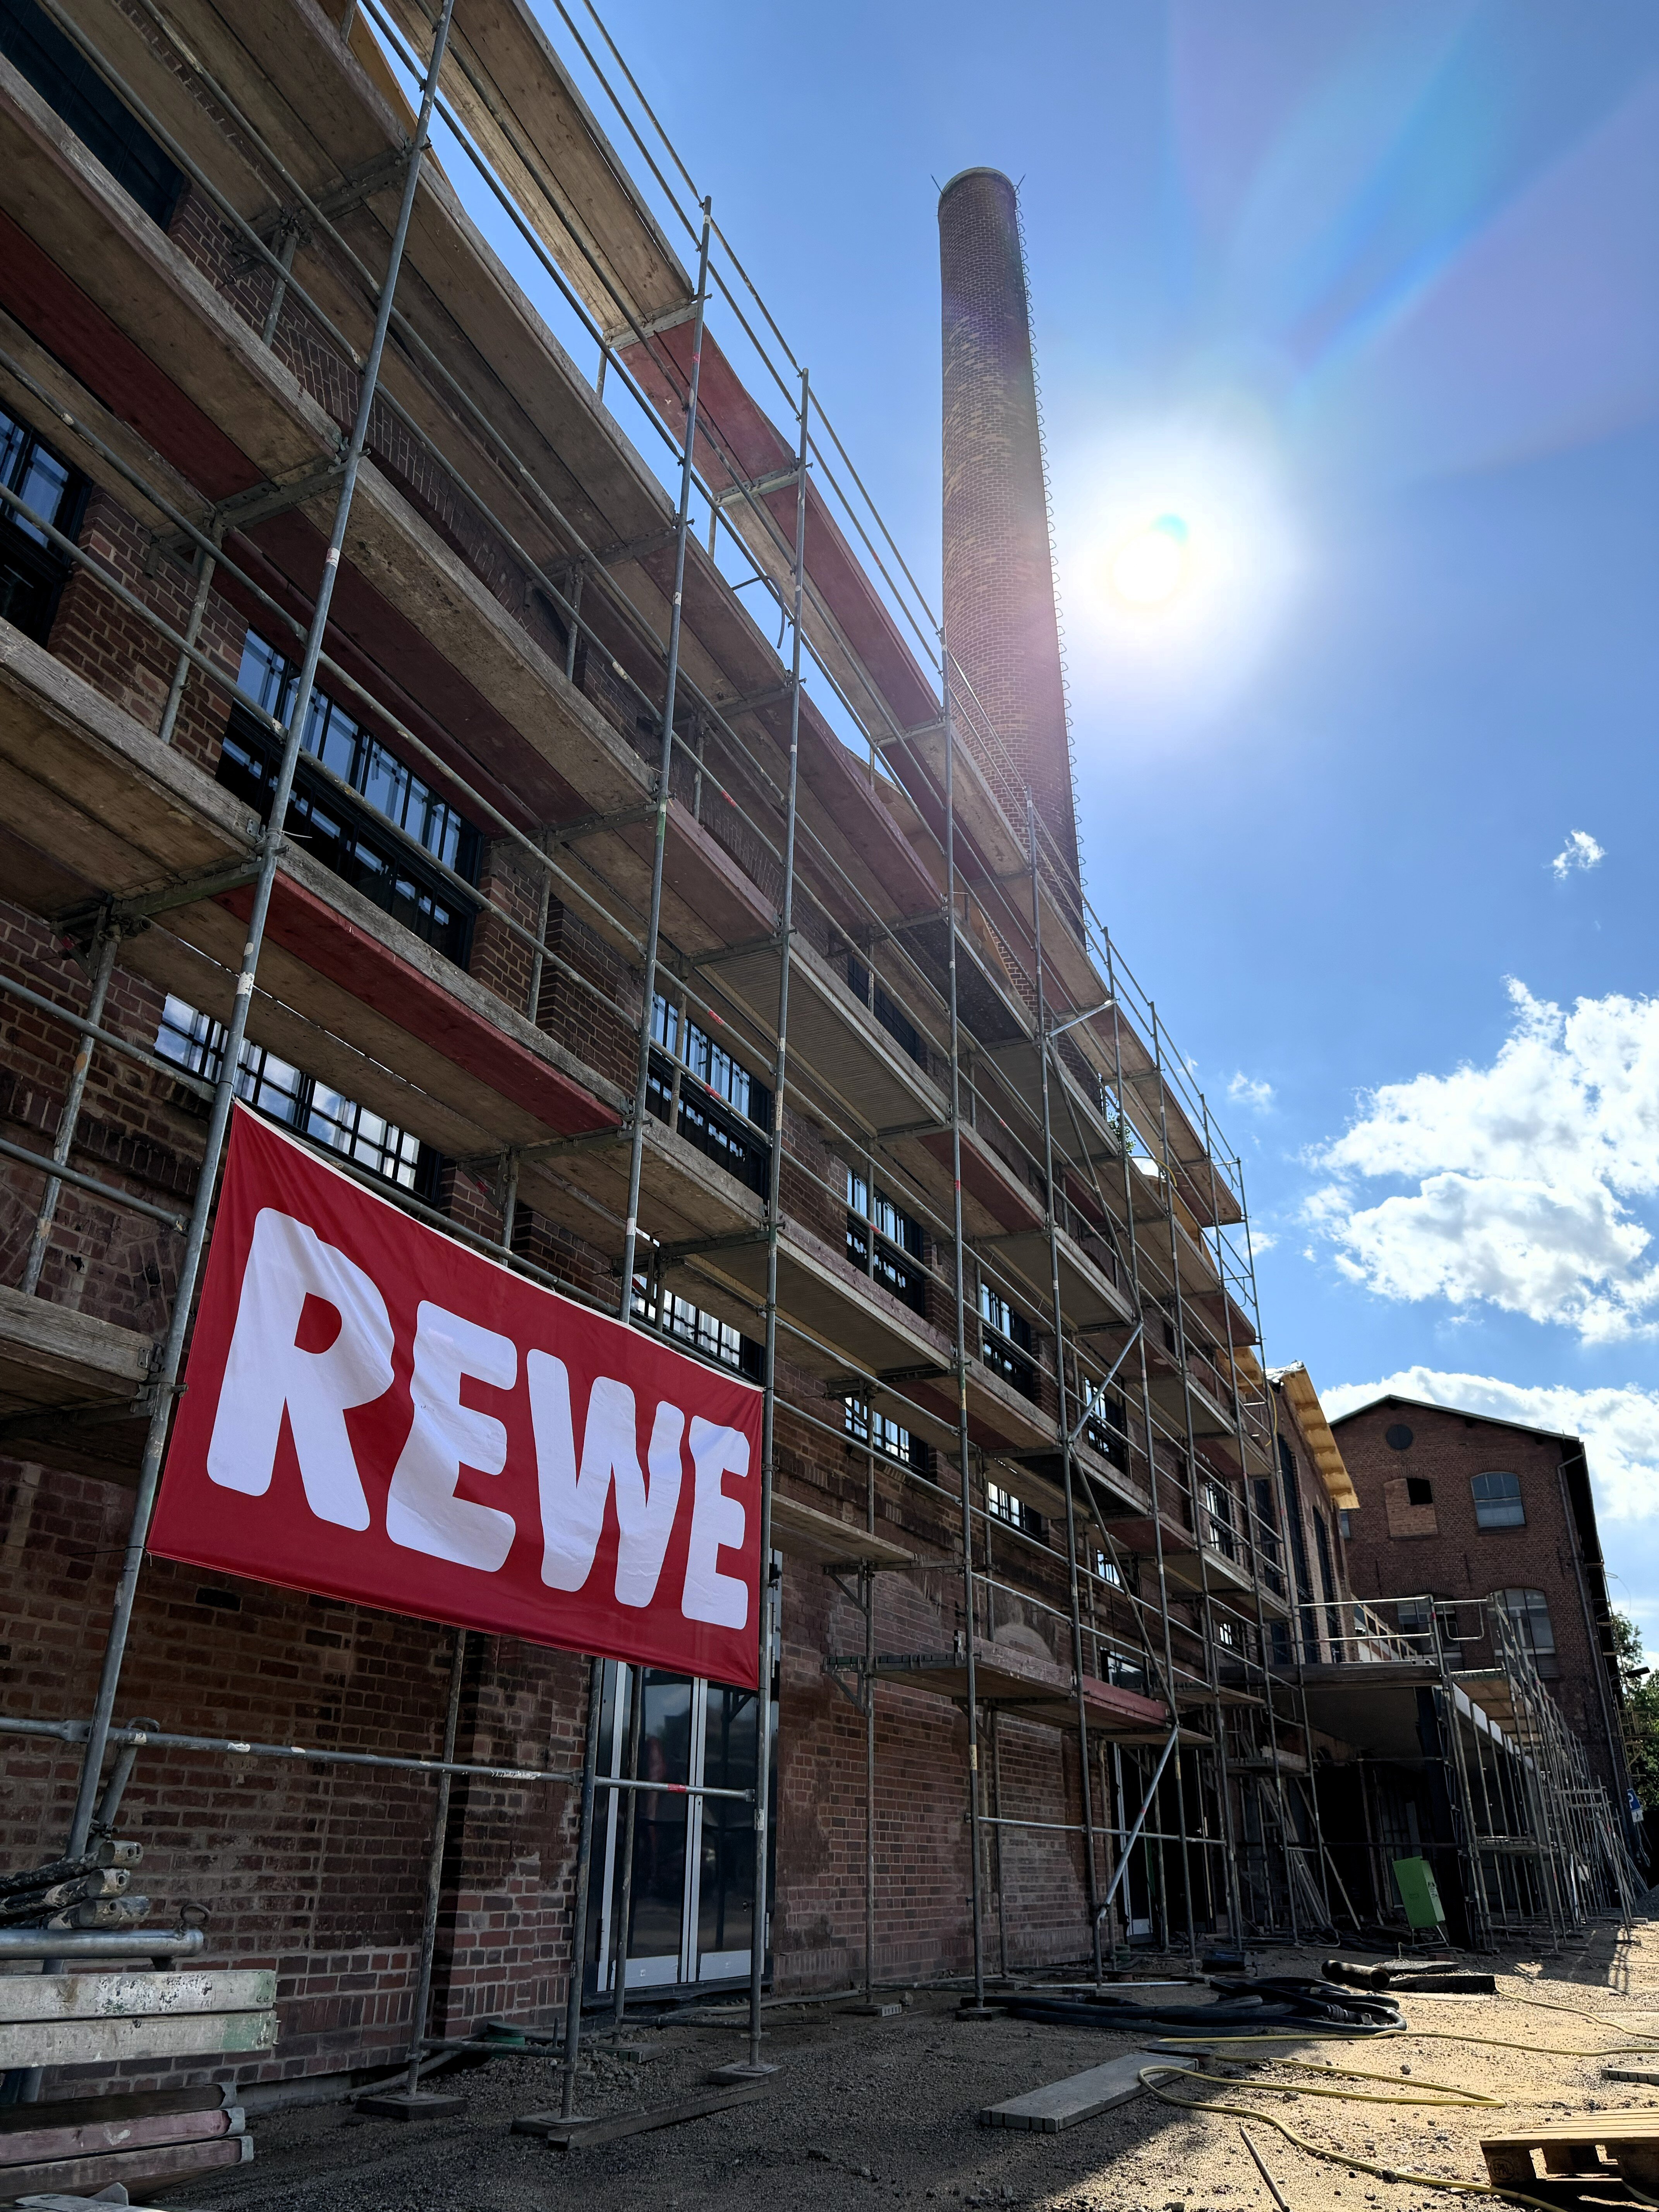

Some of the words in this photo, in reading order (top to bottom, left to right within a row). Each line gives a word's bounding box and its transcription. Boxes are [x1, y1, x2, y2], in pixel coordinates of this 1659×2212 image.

[207, 1207, 750, 1630] REWE
[1627, 1792, 1634, 1809] P
[1493, 2164, 1512, 2176] EPAL
